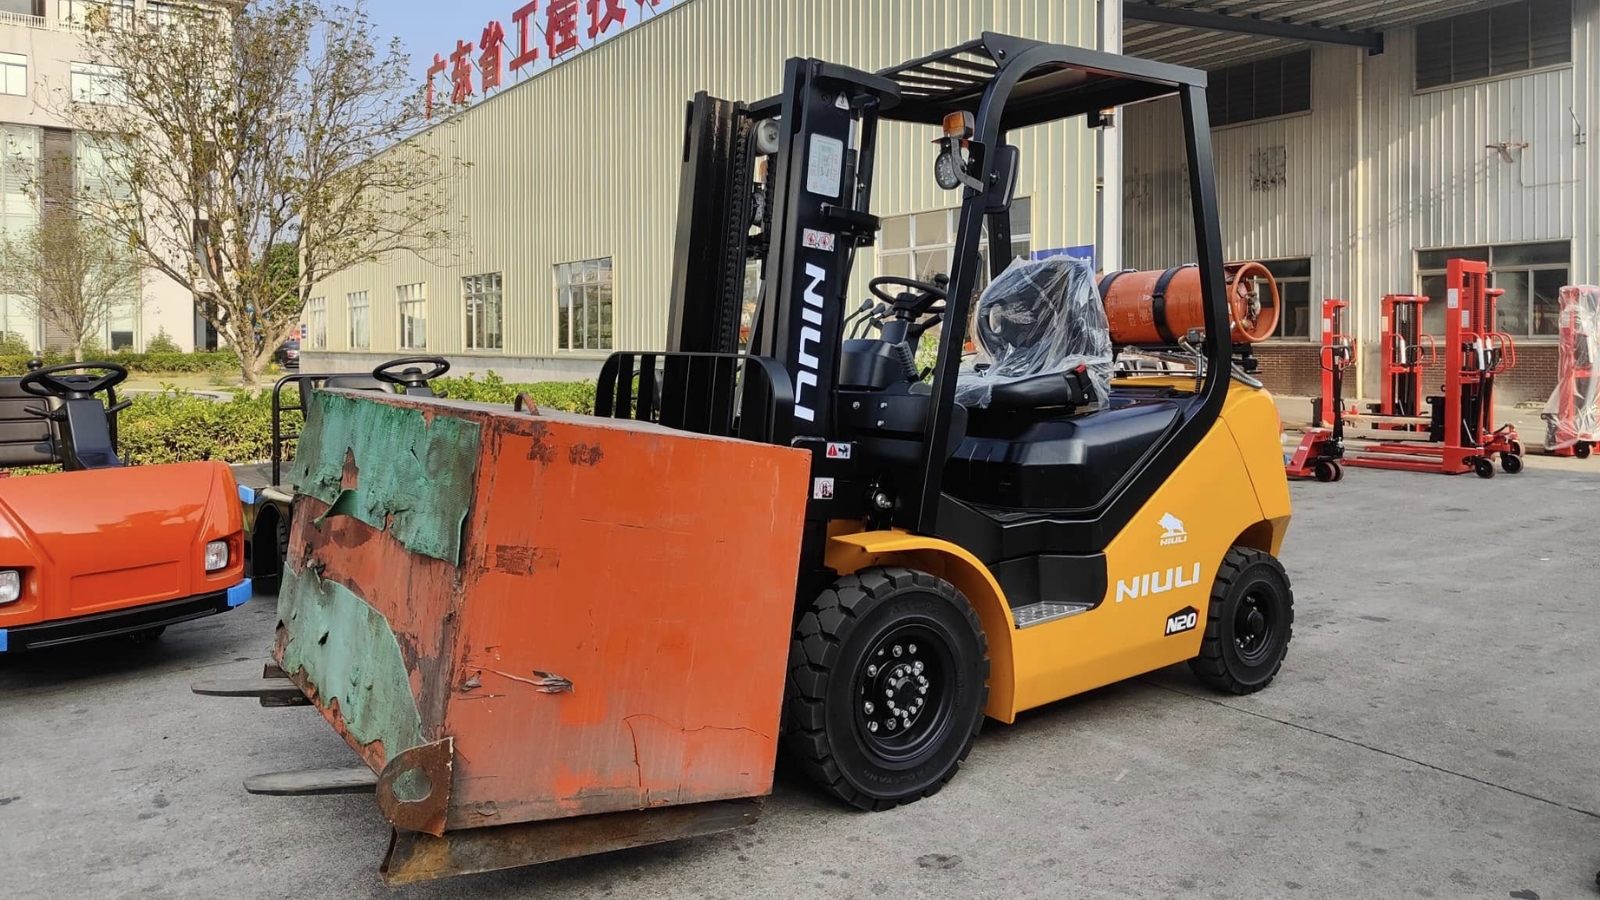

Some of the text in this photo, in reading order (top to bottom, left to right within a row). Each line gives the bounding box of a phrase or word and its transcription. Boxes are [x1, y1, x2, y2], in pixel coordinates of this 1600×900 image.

[794, 262, 825, 421] NIULI
[1160, 536, 1187, 546] NIULI
[1116, 562, 1200, 603] NIULI
[1166, 612, 1196, 634] N20
